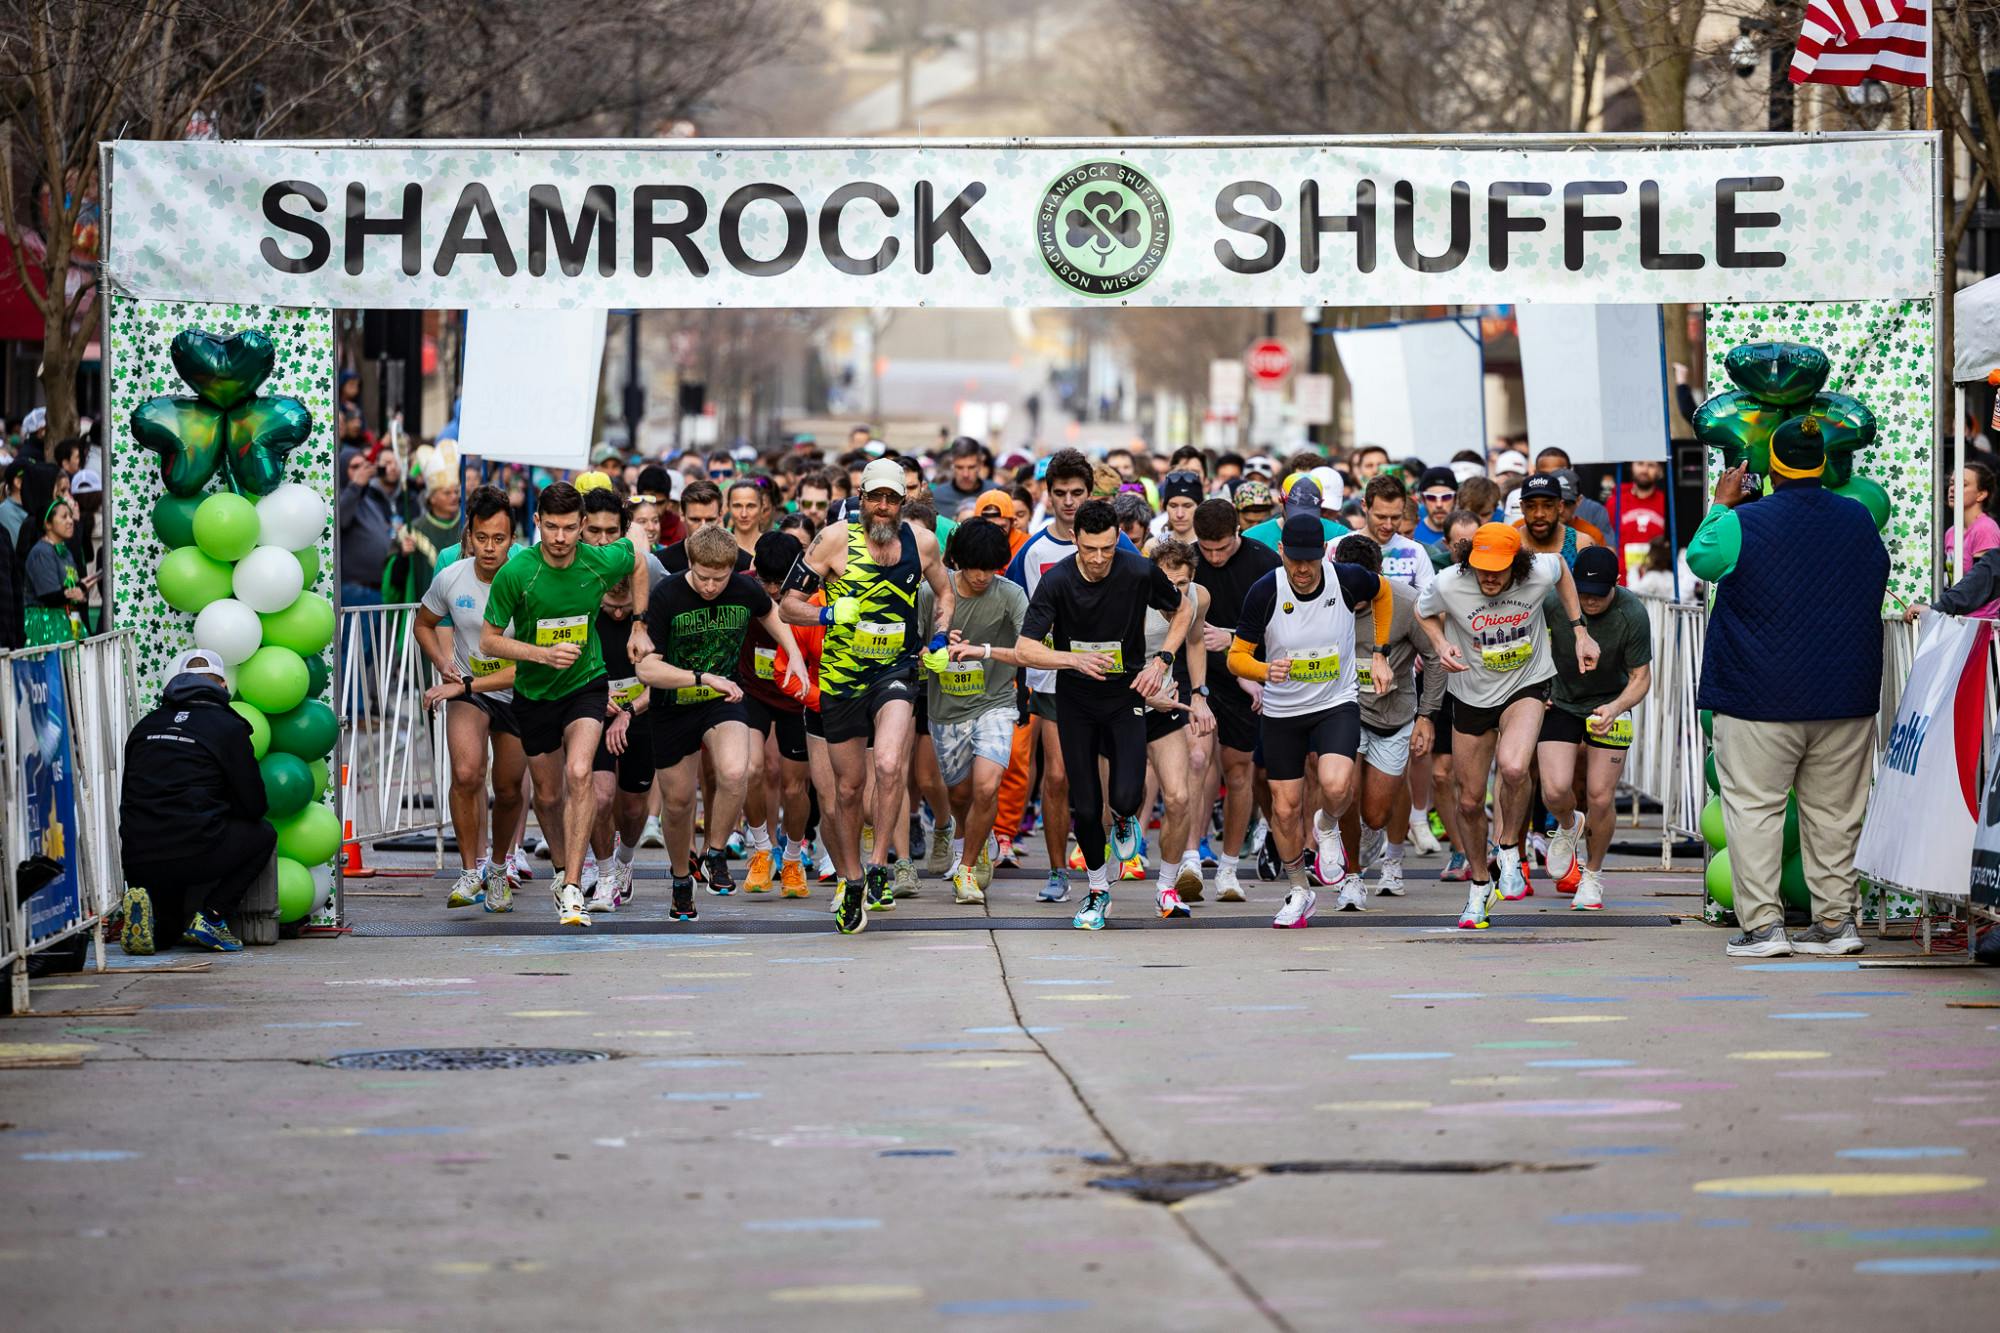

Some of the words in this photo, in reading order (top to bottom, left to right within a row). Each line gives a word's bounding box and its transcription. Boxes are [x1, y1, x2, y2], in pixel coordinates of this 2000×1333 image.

[1042, 166, 1108, 222] SHAMROCK
[1117, 169, 1165, 220] SHUFFLE
[260, 180, 991, 278] SHAMROCK
[1214, 177, 1786, 274] SHUFFLE
[1042, 232, 1090, 288] MADISON
[1101, 232, 1165, 290] WISCONSIN
[1467, 605, 1486, 620] BANK
[1501, 599, 1533, 610] AMERICA
[673, 605, 748, 636] IRELAND
[1471, 611, 1530, 631] Chicago
[552, 629, 571, 640] 246
[872, 636, 887, 645] 114
[1499, 651, 1517, 661] 194
[481, 661, 500, 671] 298
[1308, 661, 1320, 670] 97
[954, 674, 971, 683] 387
[696, 688, 709, 697] 39
